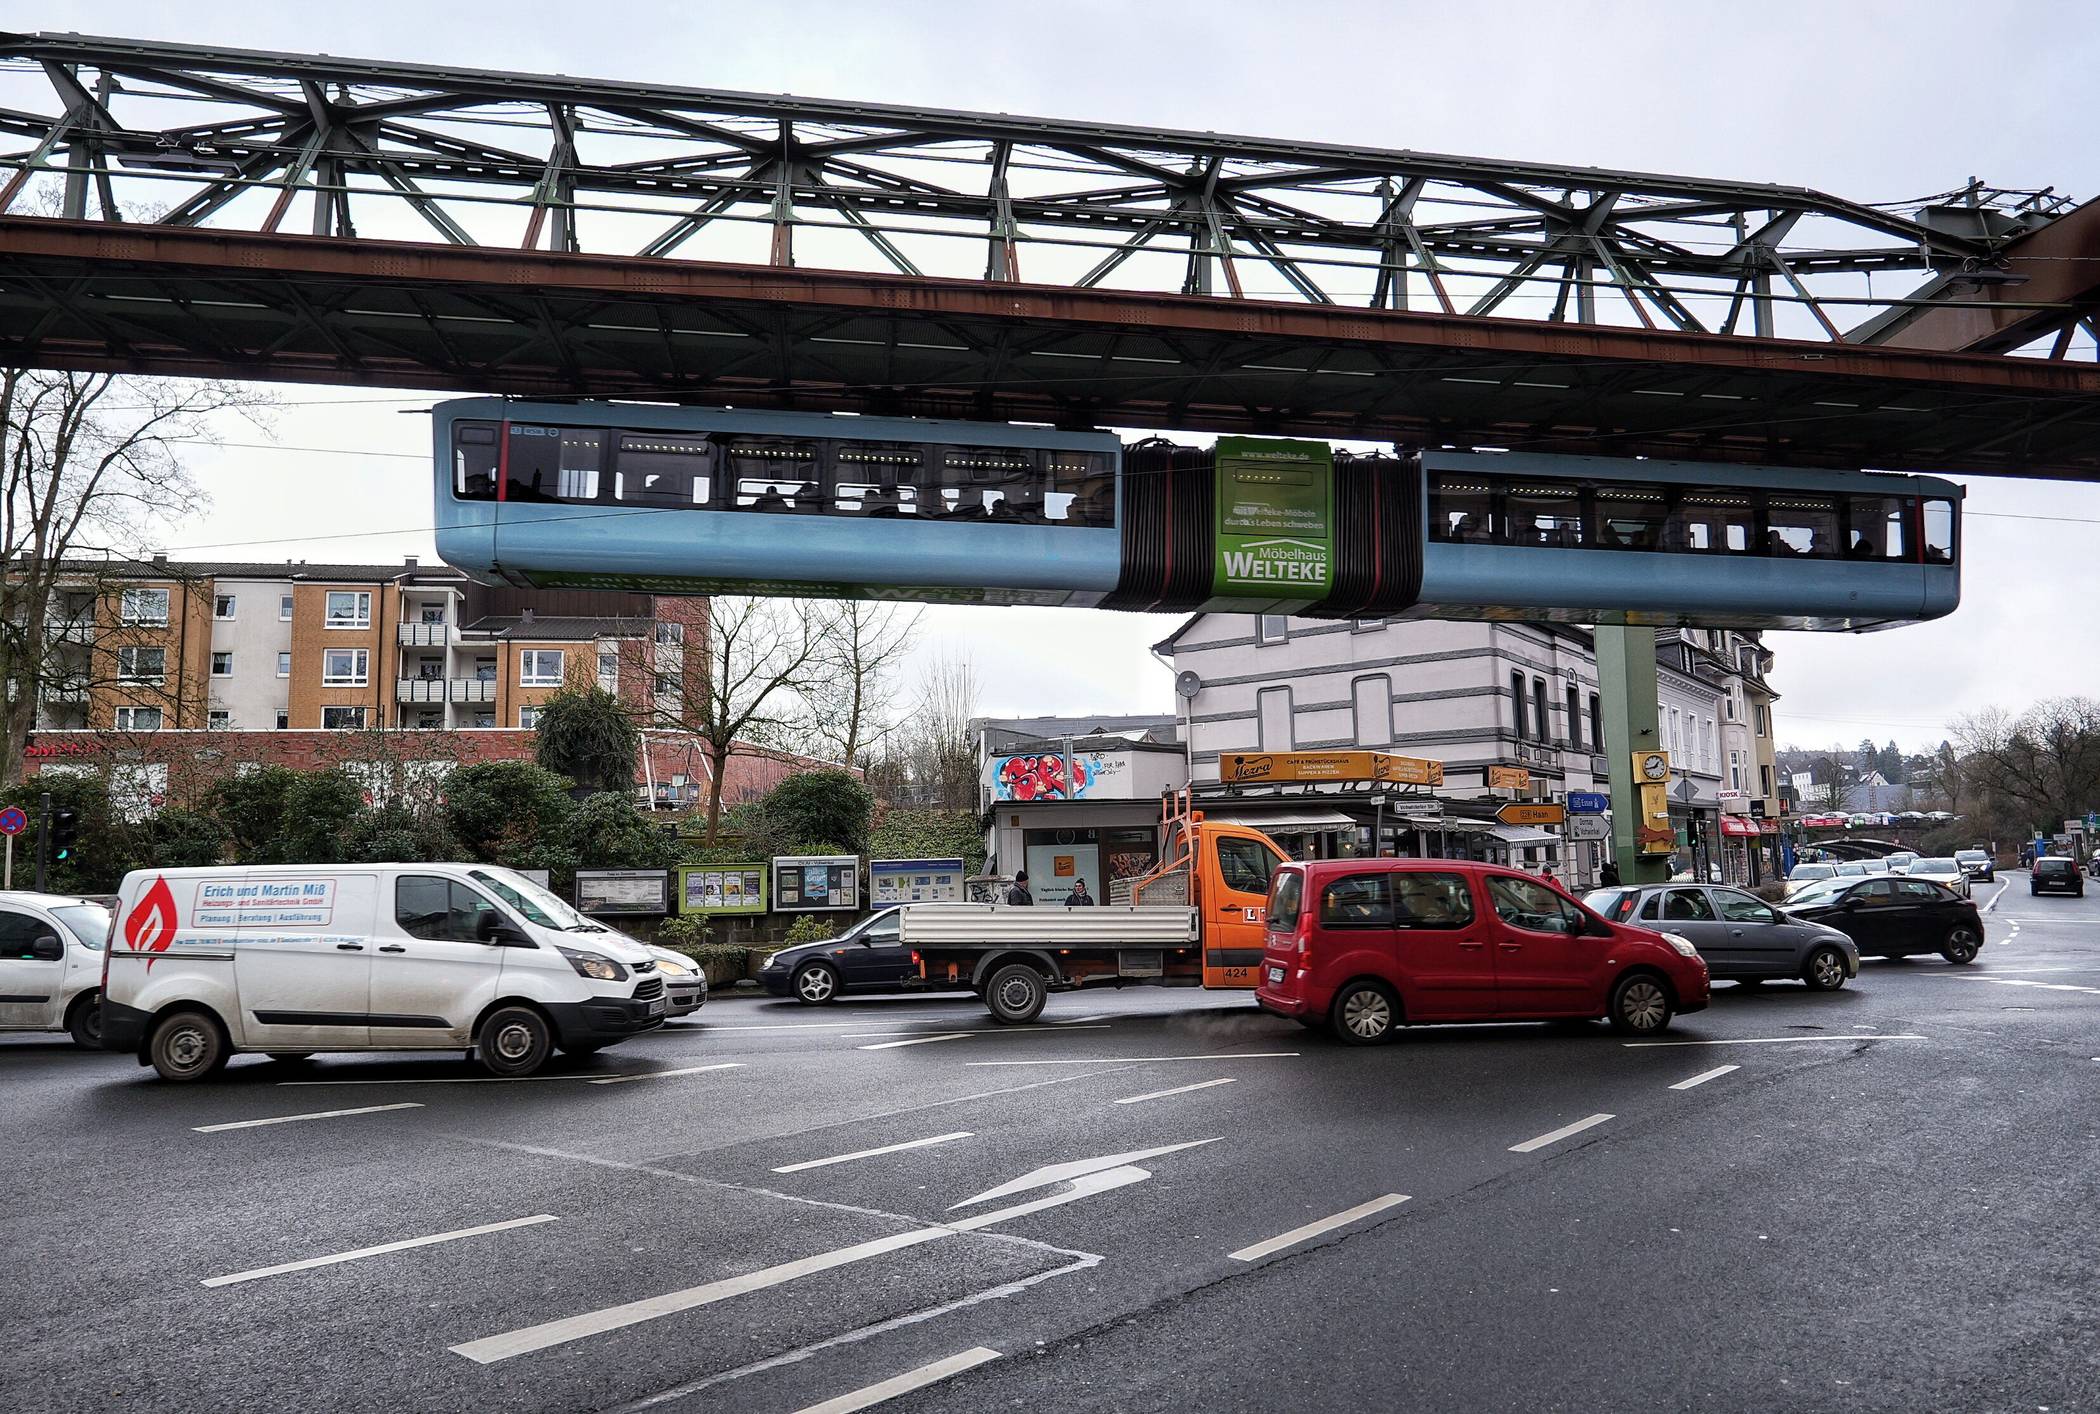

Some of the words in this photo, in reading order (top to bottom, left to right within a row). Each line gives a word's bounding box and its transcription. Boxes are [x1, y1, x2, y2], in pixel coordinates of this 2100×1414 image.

[1241, 451, 1310, 460] www.welteke.de
[1256, 518, 1281, 527] Leben
[1283, 519, 1324, 529] schweben
[1259, 547, 1327, 561] Möbelhaus
[1223, 551, 1327, 580] WELTEKE
[1228, 760, 1272, 779] Mezra
[1533, 810, 1549, 819] Haan
[204, 885, 234, 897] Erich
[237, 885, 259, 897] und
[262, 884, 300, 896] Martin
[303, 884, 327, 896] Miß
[302, 897, 324, 905] GmbH
[200, 914, 231, 923] Planung
[238, 914, 272, 923] Beratung
[279, 913, 323, 922] Ausführung
[1225, 968, 1248, 978] 424
